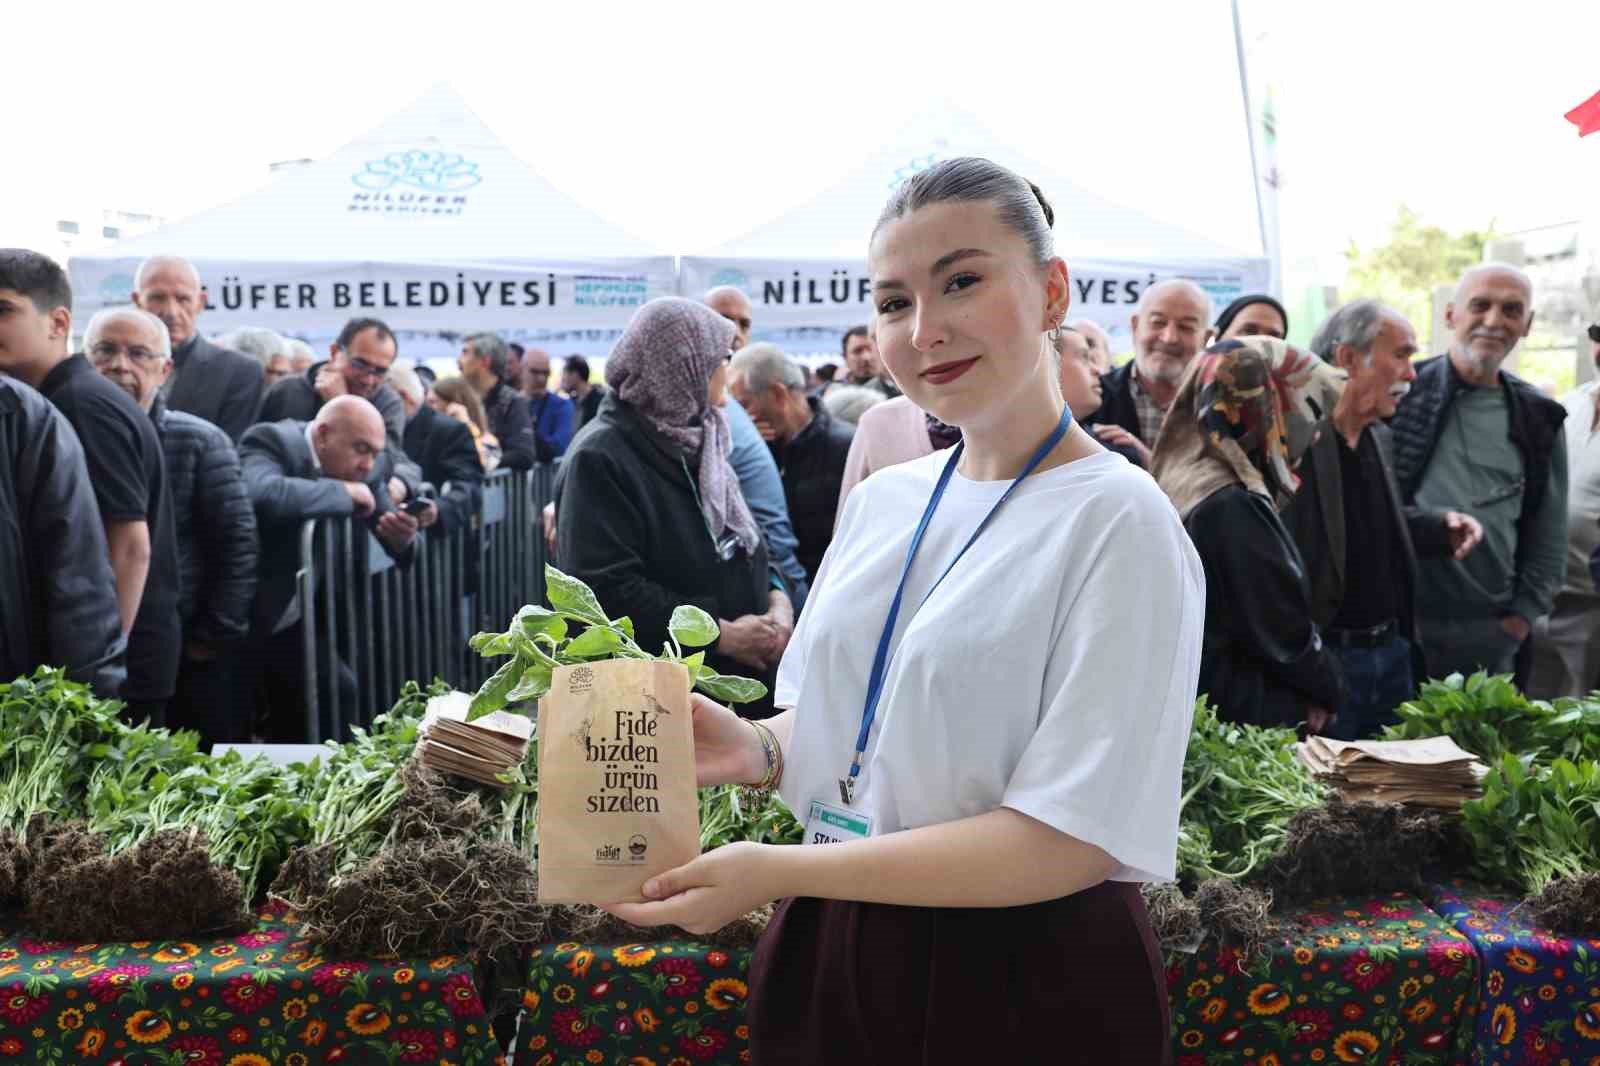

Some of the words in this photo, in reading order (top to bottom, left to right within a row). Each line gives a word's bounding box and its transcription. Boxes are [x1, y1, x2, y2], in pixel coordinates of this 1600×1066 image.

[201, 276, 317, 311] LÜFER
[332, 272, 556, 308] BELEDİYESİ
[762, 270, 873, 304] NİLÜF
[614, 710, 658, 741] Fide
[585, 735, 659, 763] bizden
[603, 764, 659, 790] ürün
[585, 786, 660, 813] sizden
[812, 831, 843, 845] STA
